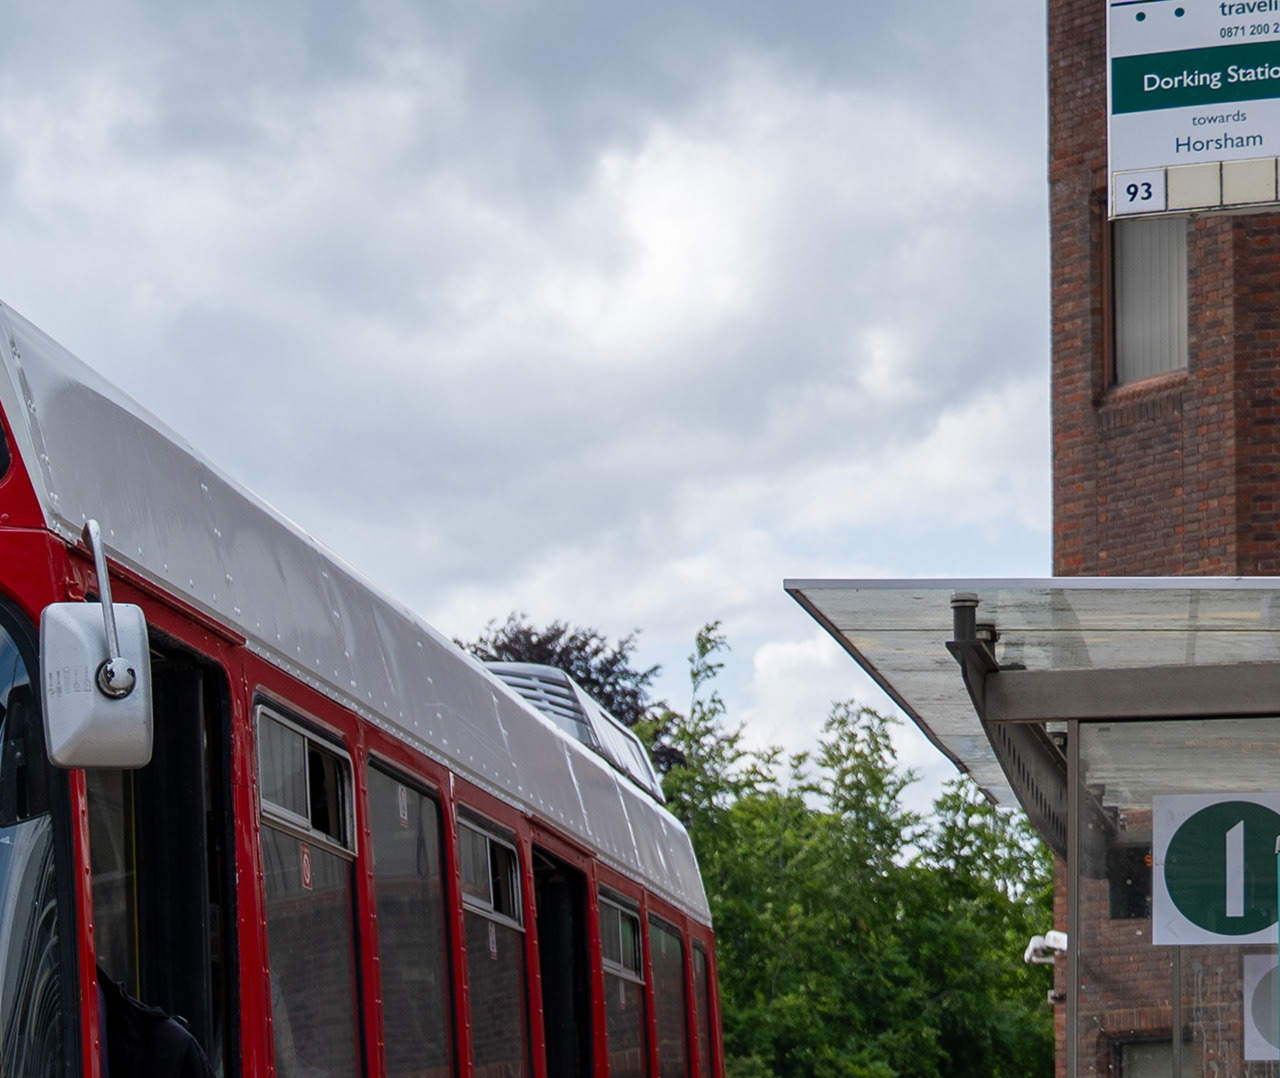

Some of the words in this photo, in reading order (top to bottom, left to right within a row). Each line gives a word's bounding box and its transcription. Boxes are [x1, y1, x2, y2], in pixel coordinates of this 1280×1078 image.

[1220, 26, 1245, 39] 0871
[1250, 23, 1270, 36] 200
[1143, 70, 1222, 92] Dorking
[1192, 110, 1247, 126] towards
[1175, 133, 1263, 153] Horsham
[1126, 182, 1153, 202] 93
[1225, 819, 1245, 917] 1
